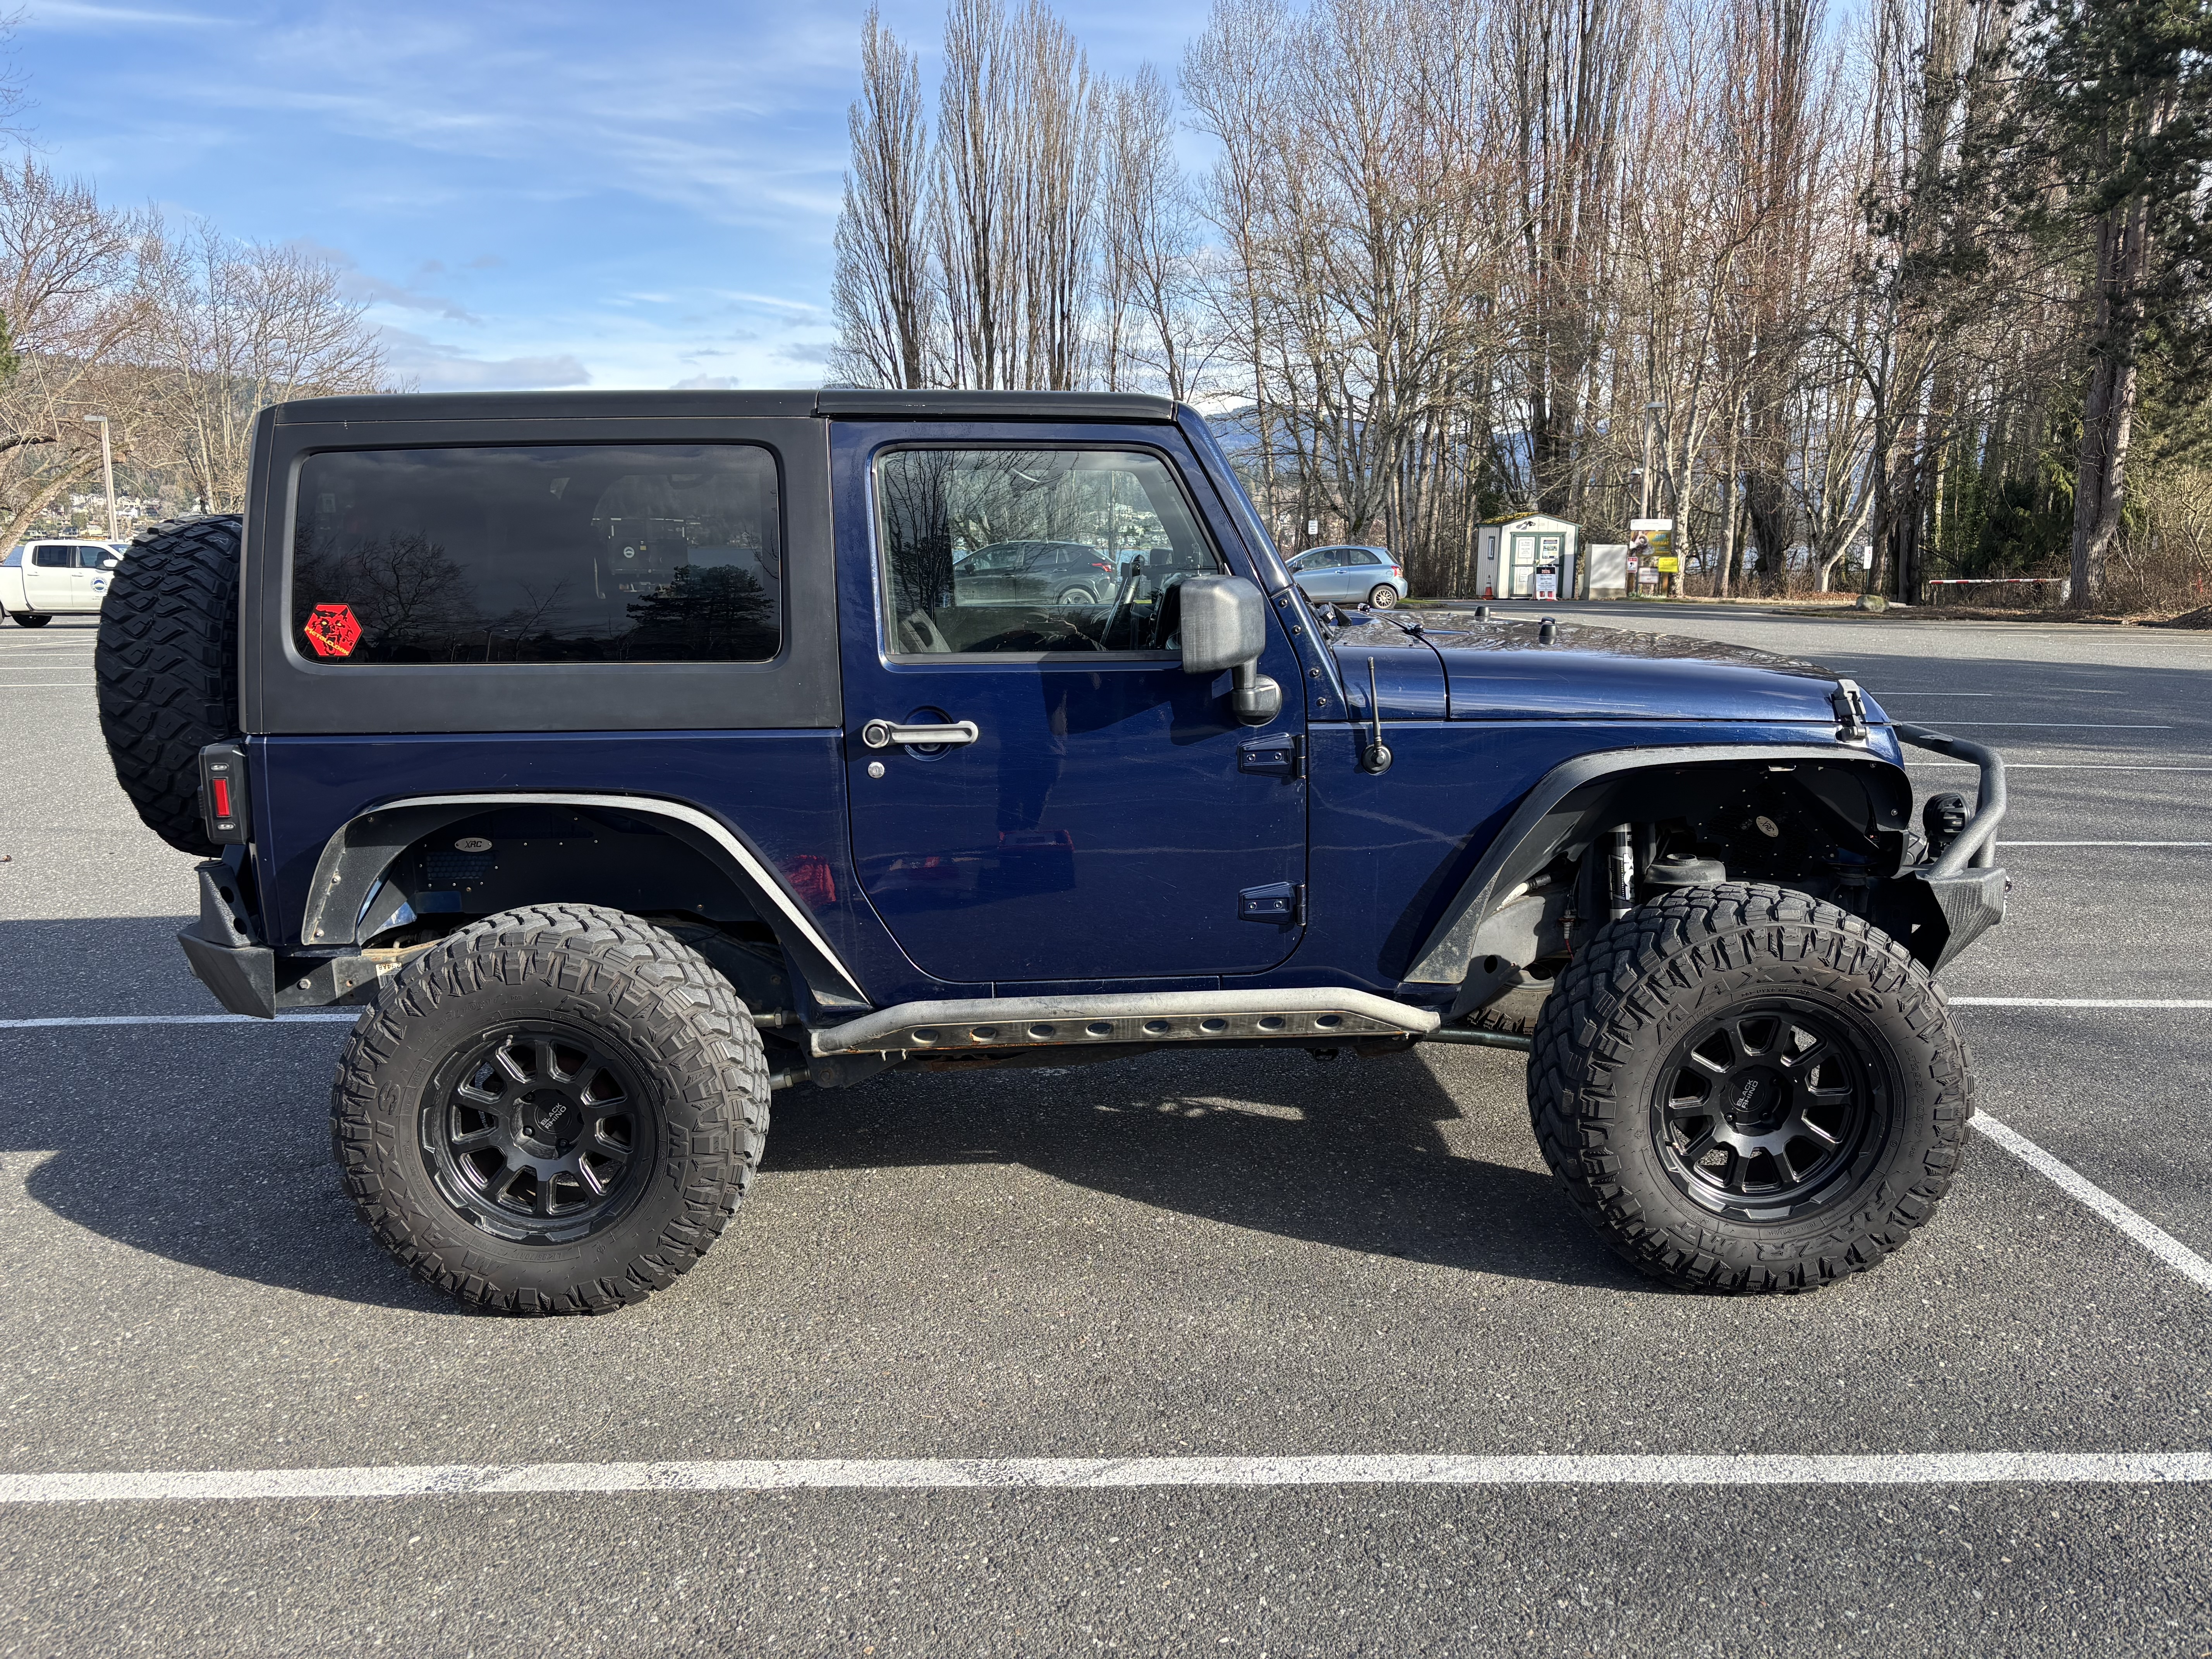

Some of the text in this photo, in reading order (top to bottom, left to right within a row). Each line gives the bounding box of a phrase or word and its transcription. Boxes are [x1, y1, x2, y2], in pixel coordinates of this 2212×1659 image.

[1760, 821, 1775, 832] XRC
[465, 840, 483, 848] XRC
[1656, 965, 1884, 1045] MAXXIS
[556, 994, 679, 1106] RAZR
[1736, 1079, 1753, 1107] BLACK
[1741, 1080, 1759, 1109] RHINO
[1905, 1048, 1925, 1137] LT295/70R17
[540, 1103, 562, 1126] BLACK
[544, 1106, 567, 1130] RHINO
[375, 1080, 509, 1276] MAXXIS
[1754, 1180, 1896, 1262] RAZR
